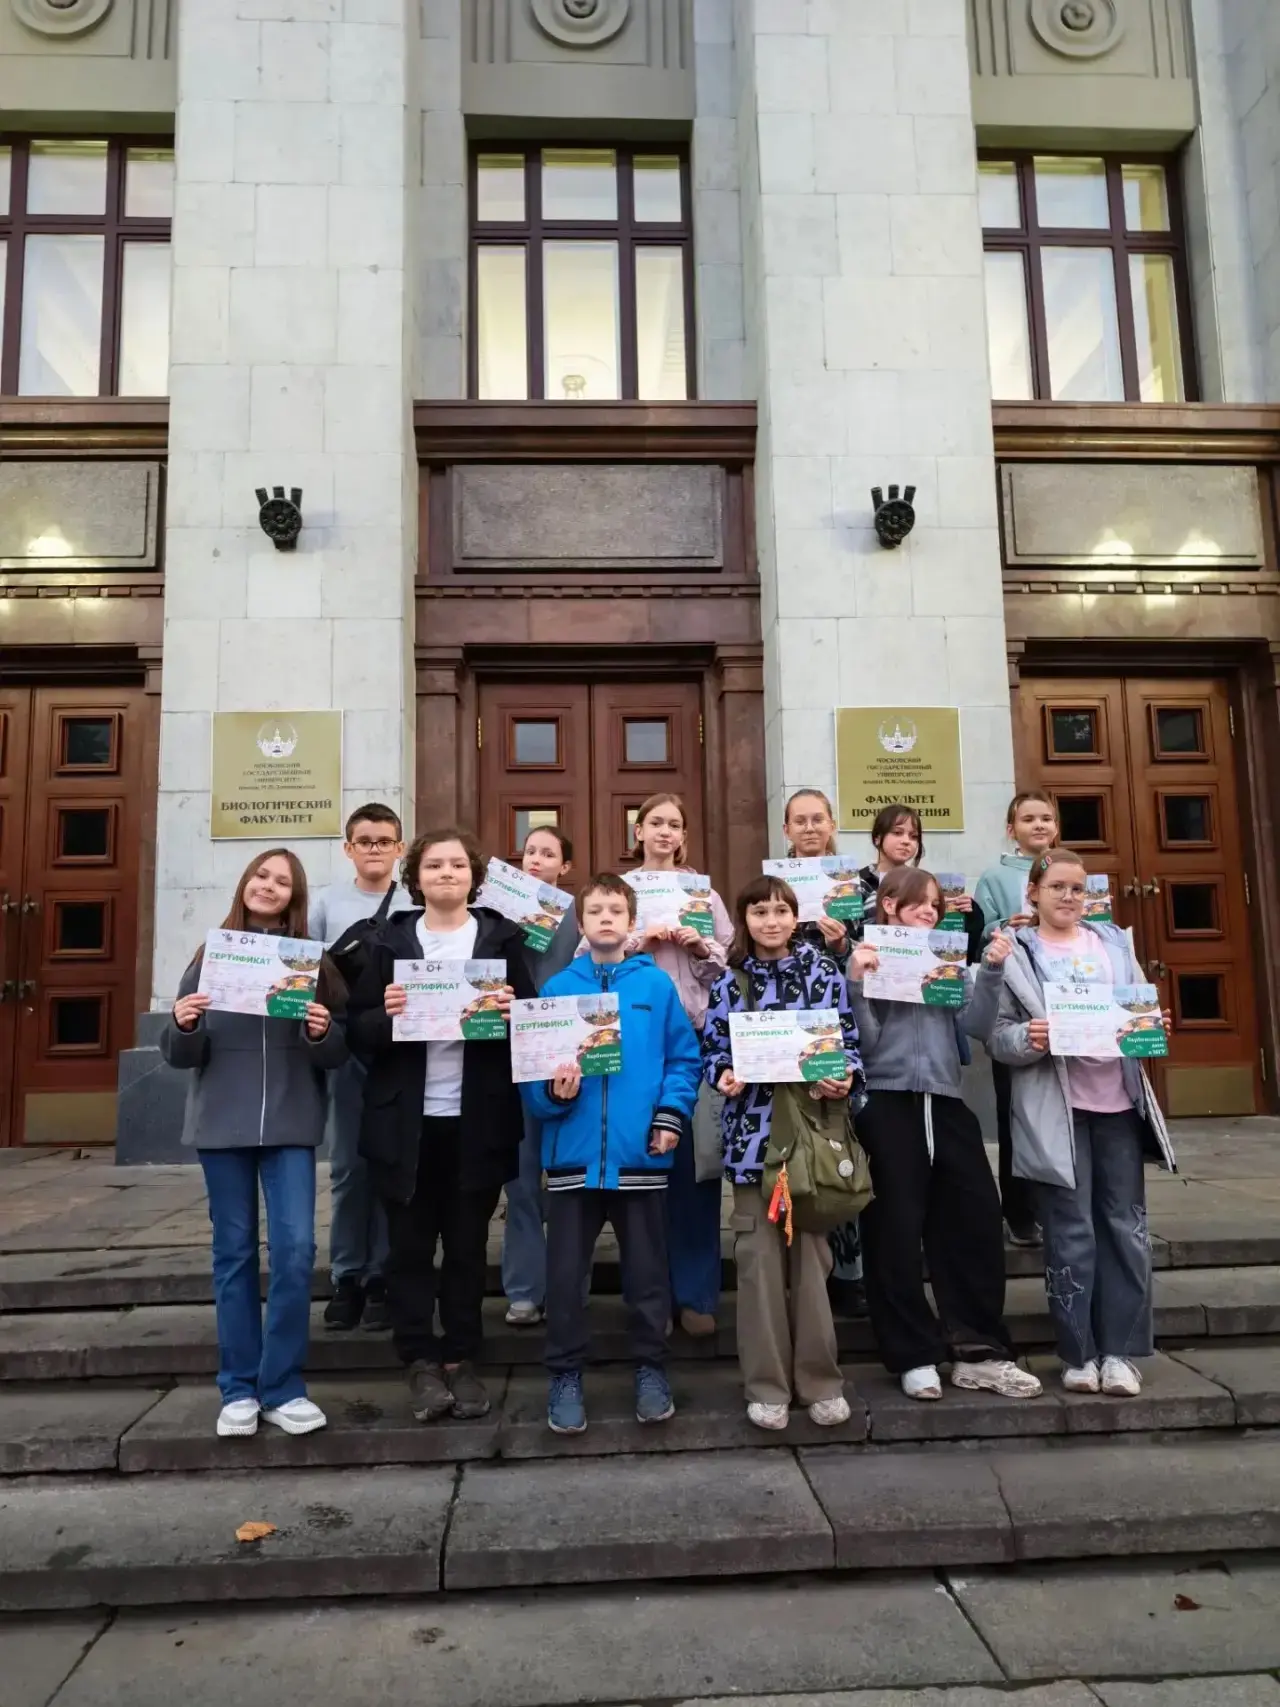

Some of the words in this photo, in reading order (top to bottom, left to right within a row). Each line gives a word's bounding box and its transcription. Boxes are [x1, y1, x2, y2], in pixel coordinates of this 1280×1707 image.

[865, 795, 934, 804] ФАКУЛЬТЕТ
[221, 799, 332, 811] БИОЛОГИЧЕСКИЙ
[852, 808, 950, 817] ПОЧЕНИЯ
[240, 814, 313, 824] ФАКУЛЬТЕТ
[209, 951, 271, 965] СЕРТИФИКАТ
[403, 982, 461, 990] ЕРТИФИКАТ
[515, 1019, 574, 1031] СЕРТИФИКАТ
